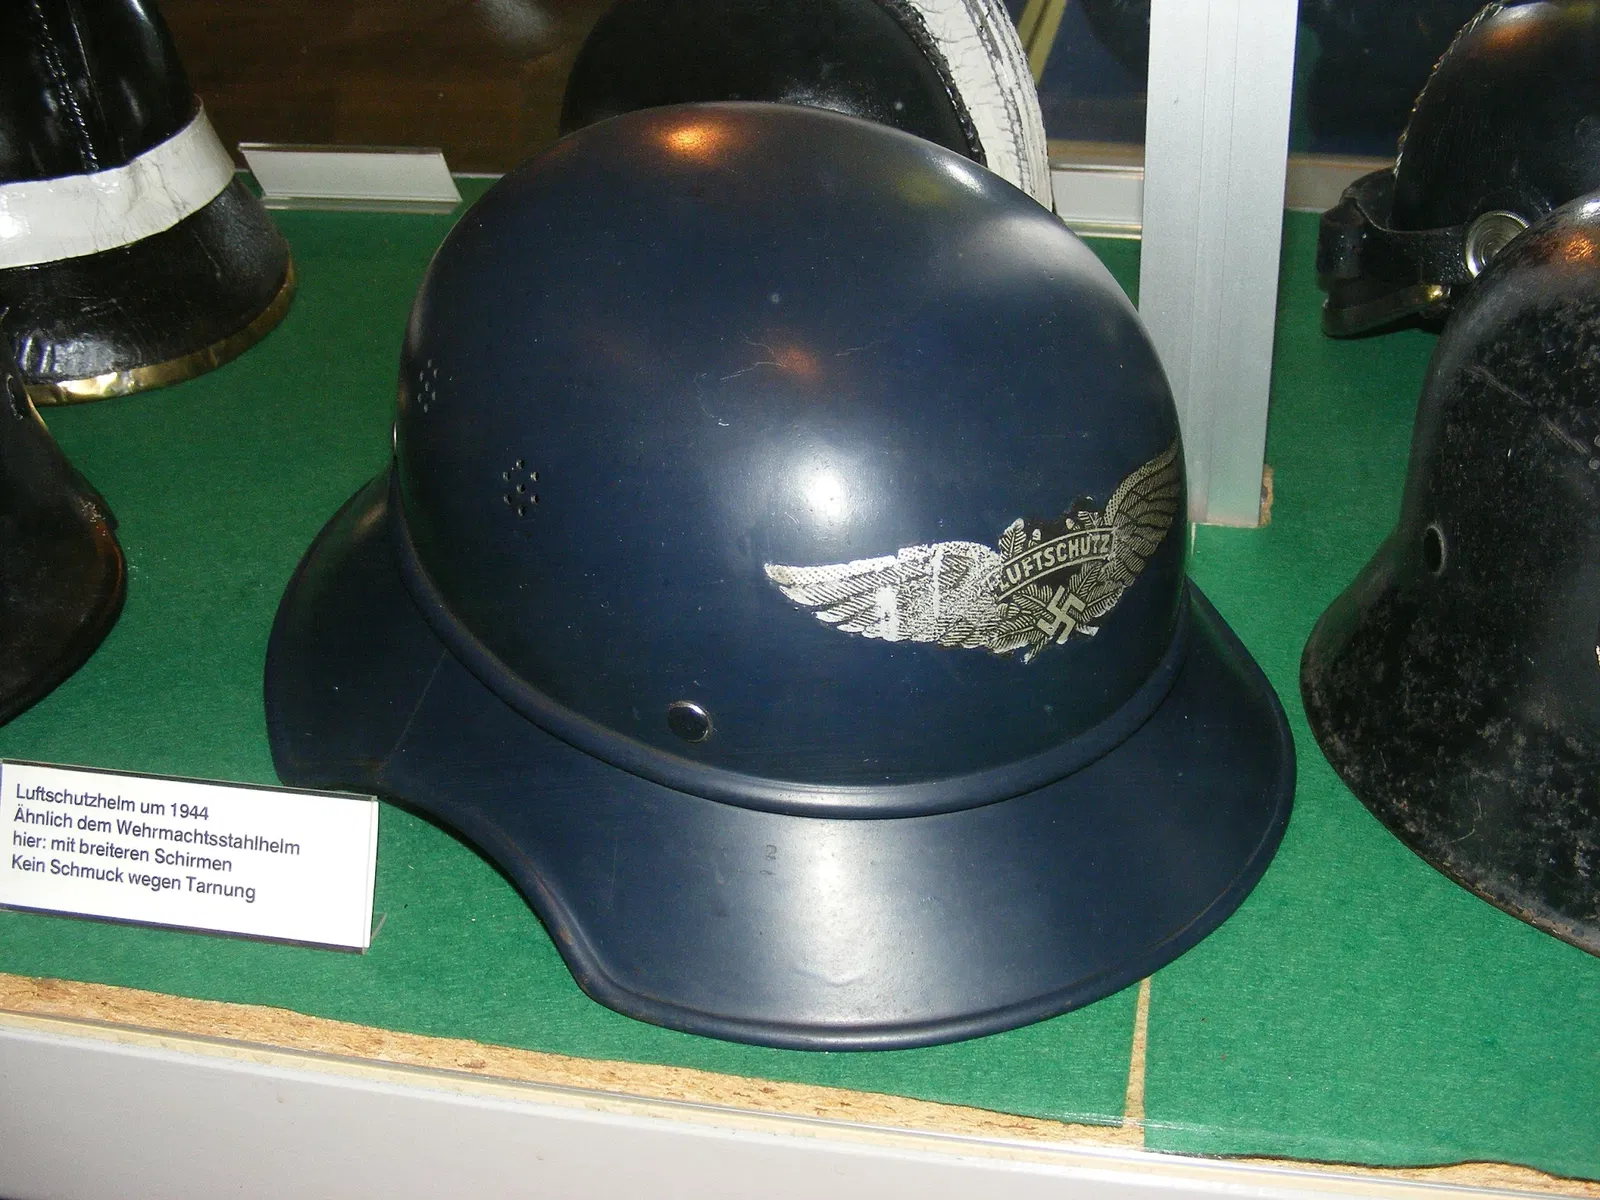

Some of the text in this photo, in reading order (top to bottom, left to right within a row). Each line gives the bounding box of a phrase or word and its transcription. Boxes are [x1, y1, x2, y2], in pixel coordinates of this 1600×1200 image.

[16, 784, 209, 821] Luftschutzhelm um 1944
[12, 831, 232, 873] hier: mit breiteren Schirmen
[14, 803, 301, 856] Ähnlich dem Wehrmachtsstahlhelm
[11, 855, 256, 903] Kein Schmuck wegen Tarnung
